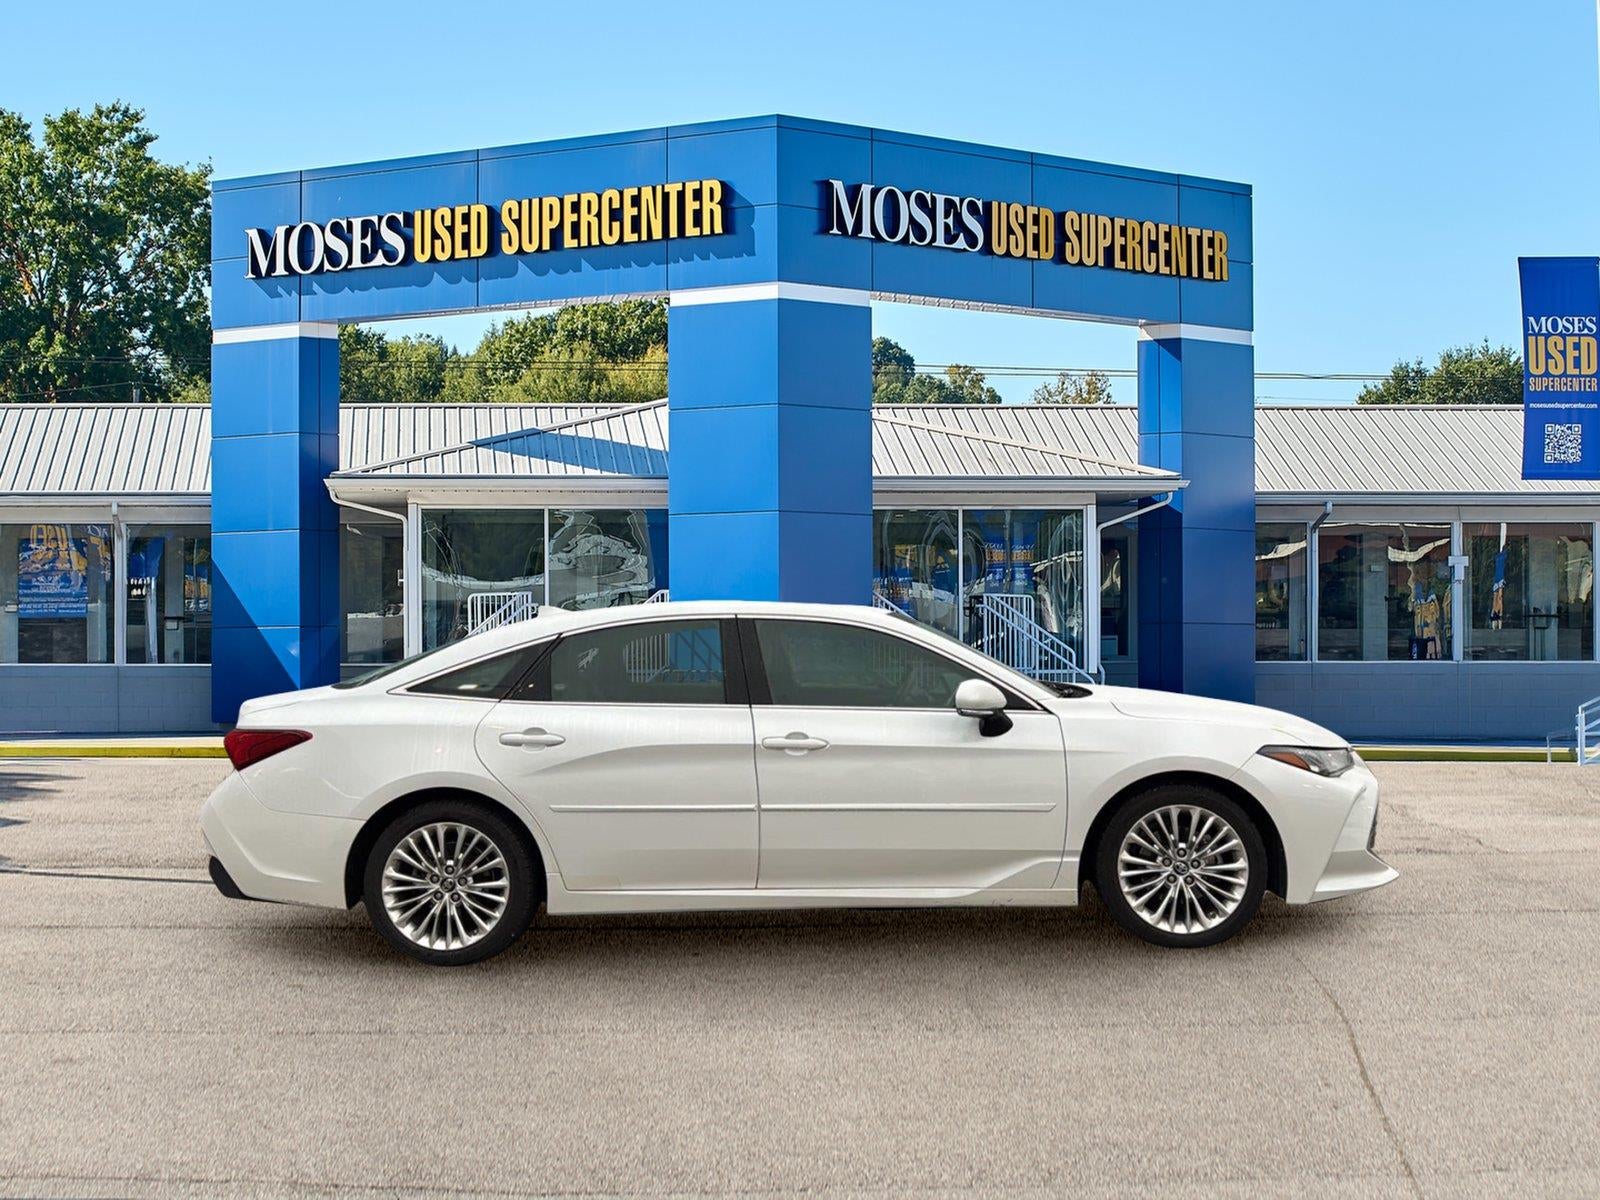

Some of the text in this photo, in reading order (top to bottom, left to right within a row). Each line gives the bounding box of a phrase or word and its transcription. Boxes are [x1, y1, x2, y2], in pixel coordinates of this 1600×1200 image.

[244, 179, 725, 279] MOSES USED SUPERCENTER
[828, 179, 1229, 281] MOSES USED SUPERCENTER
[1527, 316, 1597, 334] MOSES
[1528, 336, 1598, 375] USED
[1529, 377, 1598, 392] SUPERCENTER
